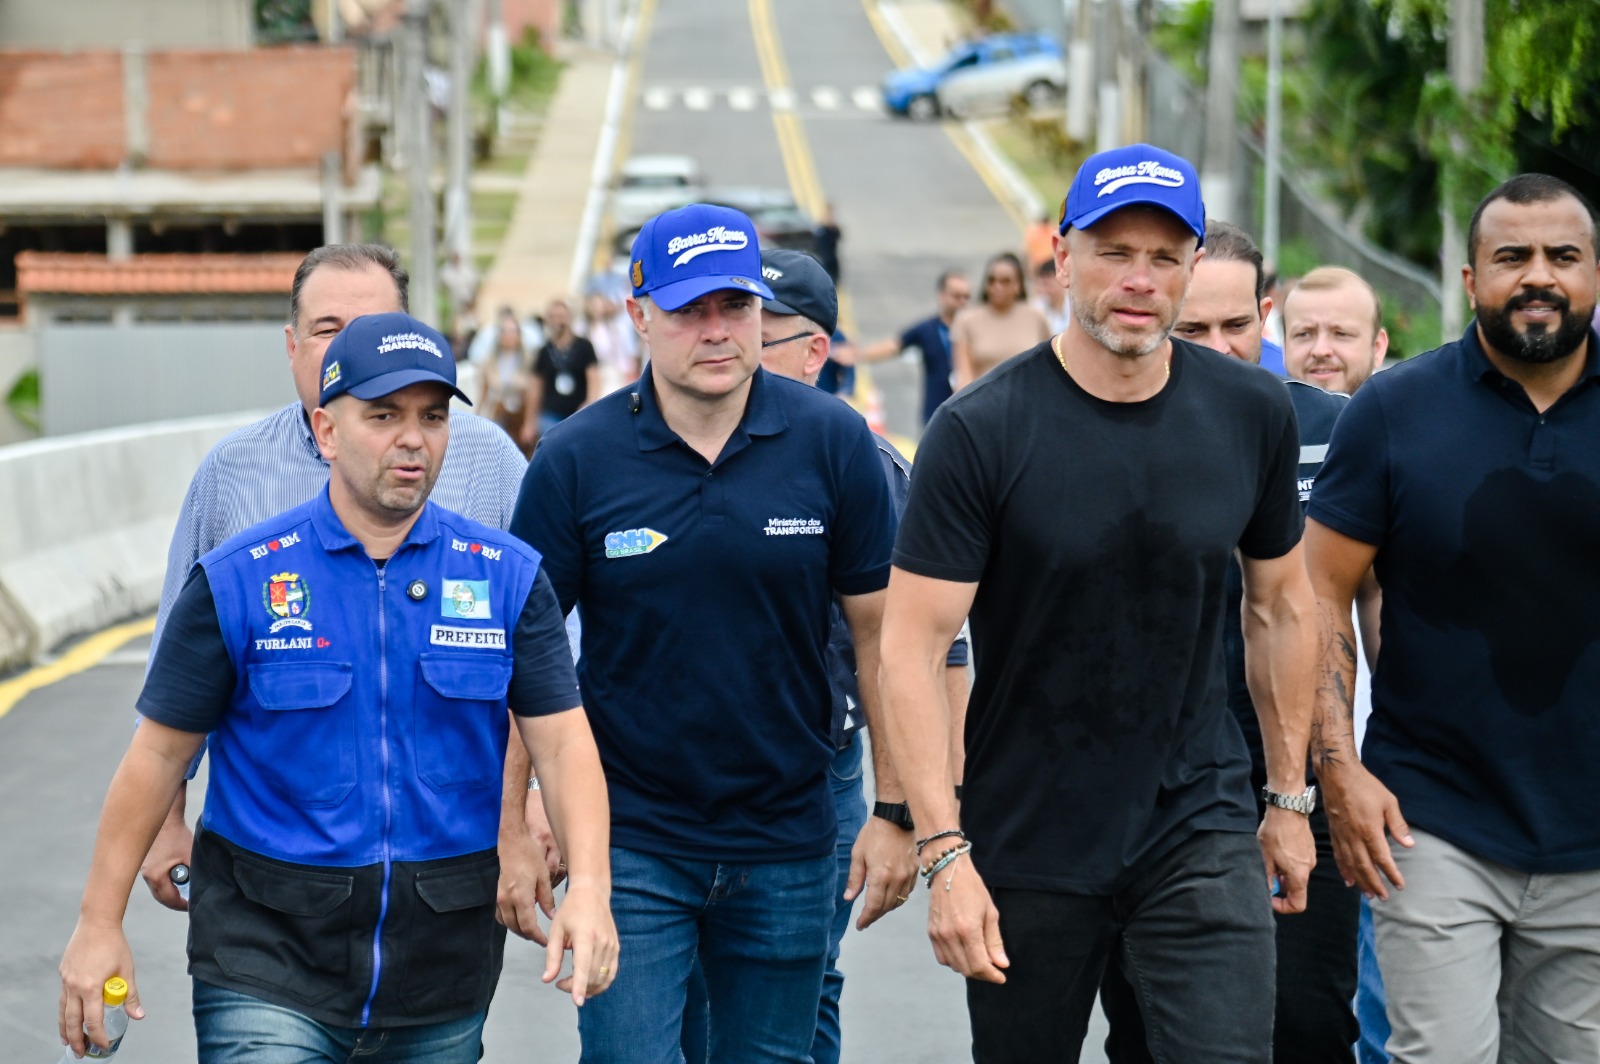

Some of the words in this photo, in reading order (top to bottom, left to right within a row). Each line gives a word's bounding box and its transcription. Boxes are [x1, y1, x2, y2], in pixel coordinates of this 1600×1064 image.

[1094, 165, 1137, 186] Barra
[1138, 161, 1184, 182] Mansa
[667, 233, 707, 255] Barra
[707, 226, 747, 244] Mansa
[382, 332, 425, 345] Ministério
[763, 526, 824, 535] TRANSPORTES
[768, 517, 807, 527] Ministério
[807, 518, 821, 526] dos
[249, 544, 269, 560] EU
[278, 532, 301, 548] BM
[451, 538, 468, 551] EU
[481, 545, 502, 561] BM
[255, 637, 312, 650] FURLANI
